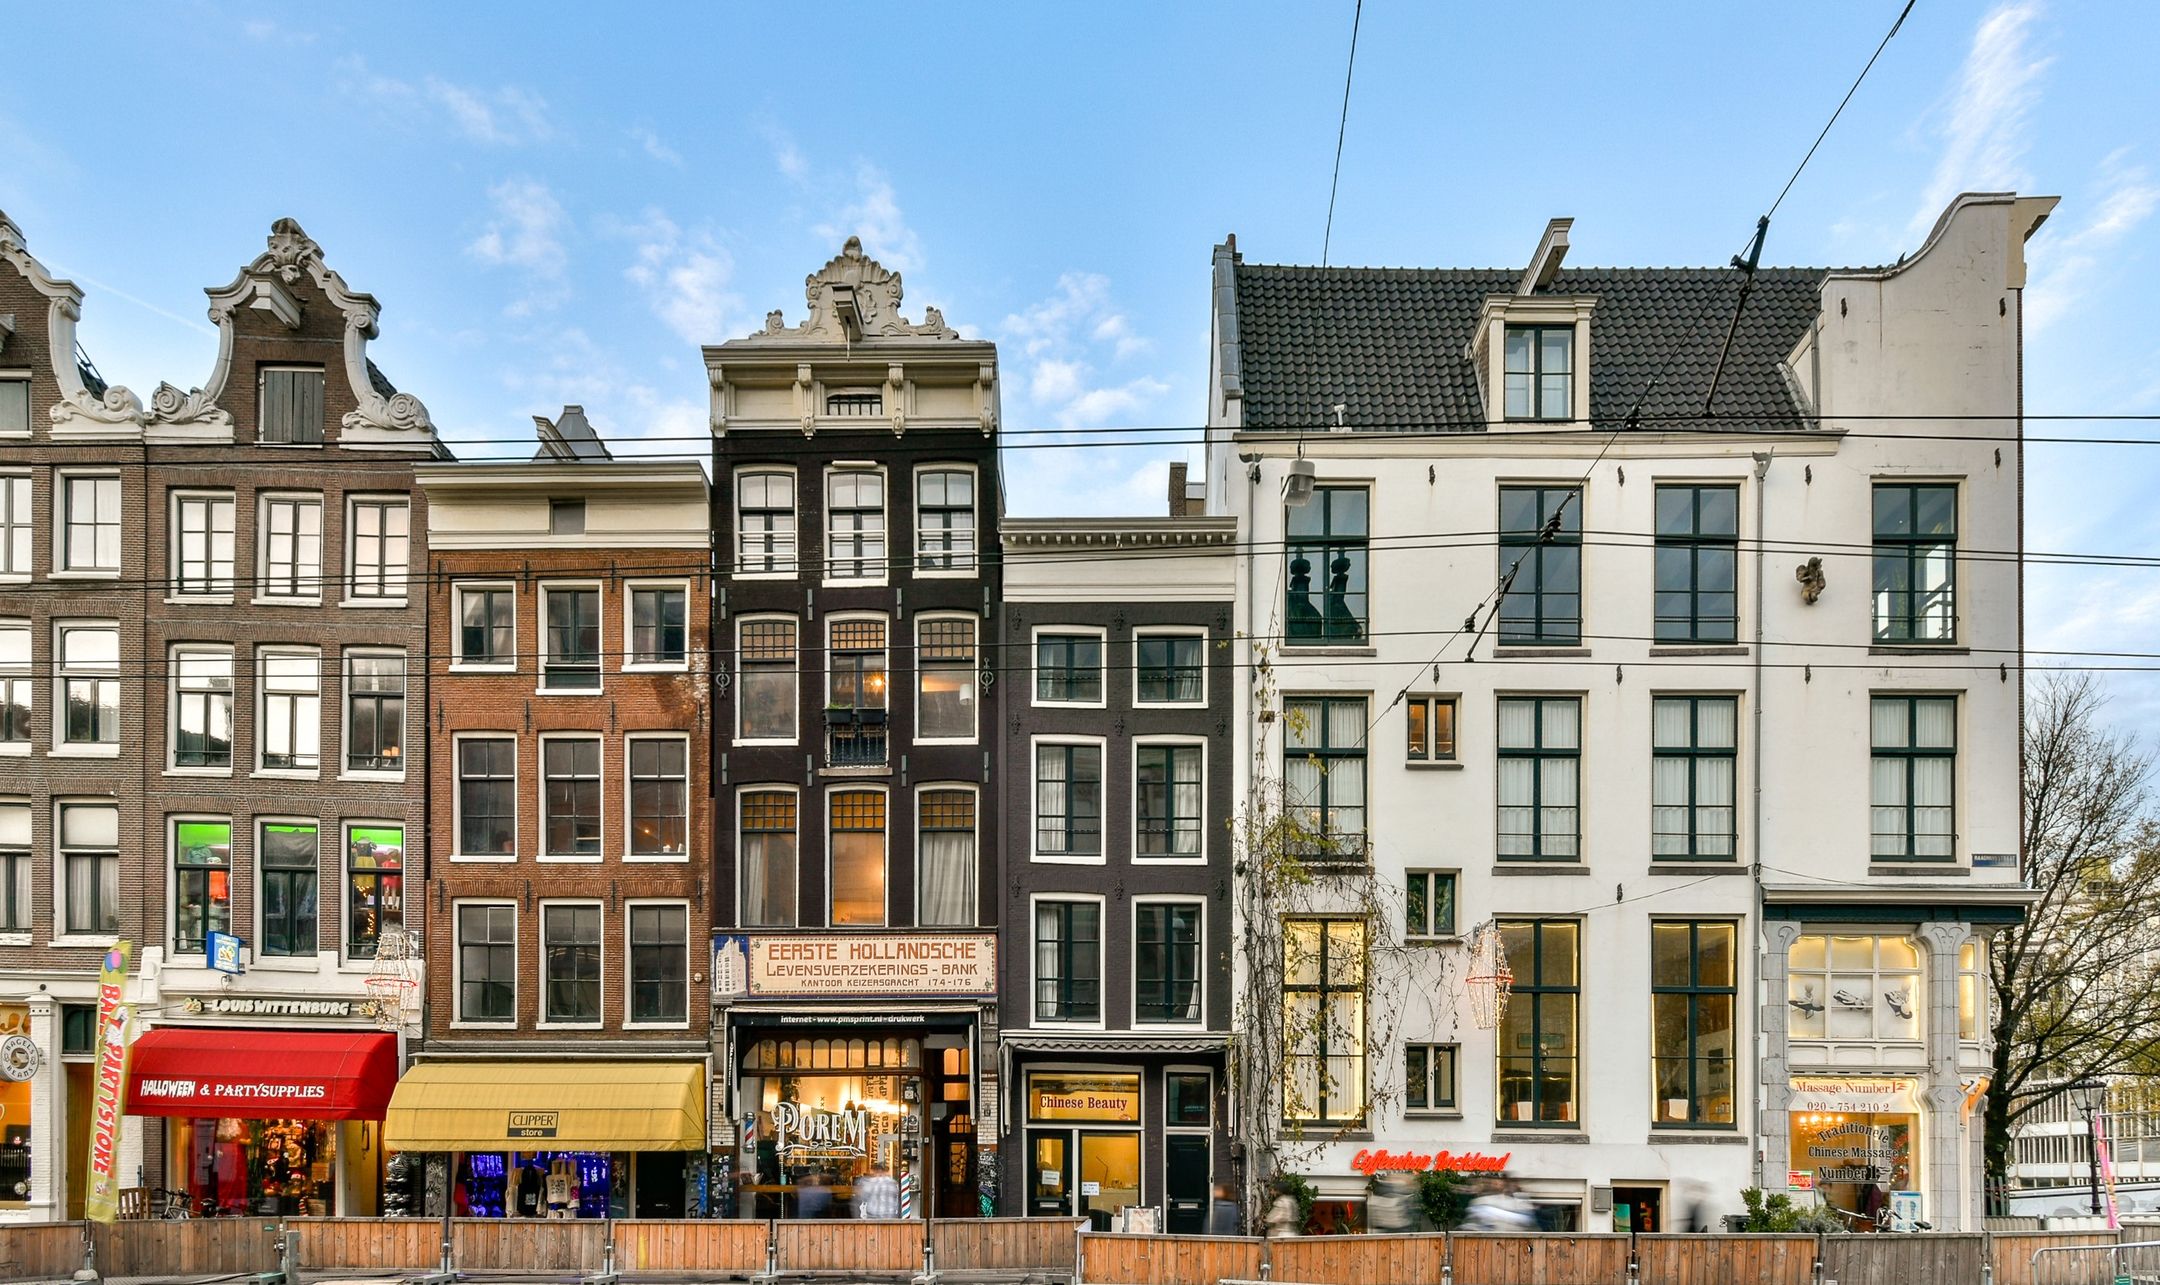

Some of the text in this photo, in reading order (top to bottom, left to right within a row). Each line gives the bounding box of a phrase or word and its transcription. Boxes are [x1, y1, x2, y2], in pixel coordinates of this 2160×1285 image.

[768, 942, 976, 960] EERSTE HOLLANDSCHE
[941, 964, 978, 975] BANK
[801, 979, 843, 987] KANTOOR
[847, 979, 919, 987] KEIZERSGRACHT
[780, 1015, 812, 1023] internet
[888, 1015, 925, 1023] drukwerk
[5, 1038, 34, 1054] BAGELS
[140, 1080, 196, 1098] HALLOWEEN
[199, 1084, 211, 1096] &
[1796, 1081, 1842, 1095] Massage
[1040, 1096, 1128, 1111] Chinese Beauty
[512, 1114, 554, 1126] CLIPPER
[771, 1102, 866, 1152] POREM
[520, 1128, 543, 1136] store
[1816, 1122, 1889, 1143] Traditionele
[1808, 1146, 1899, 1160] Chinese Massage
[1818, 1166, 1867, 1180] Number
